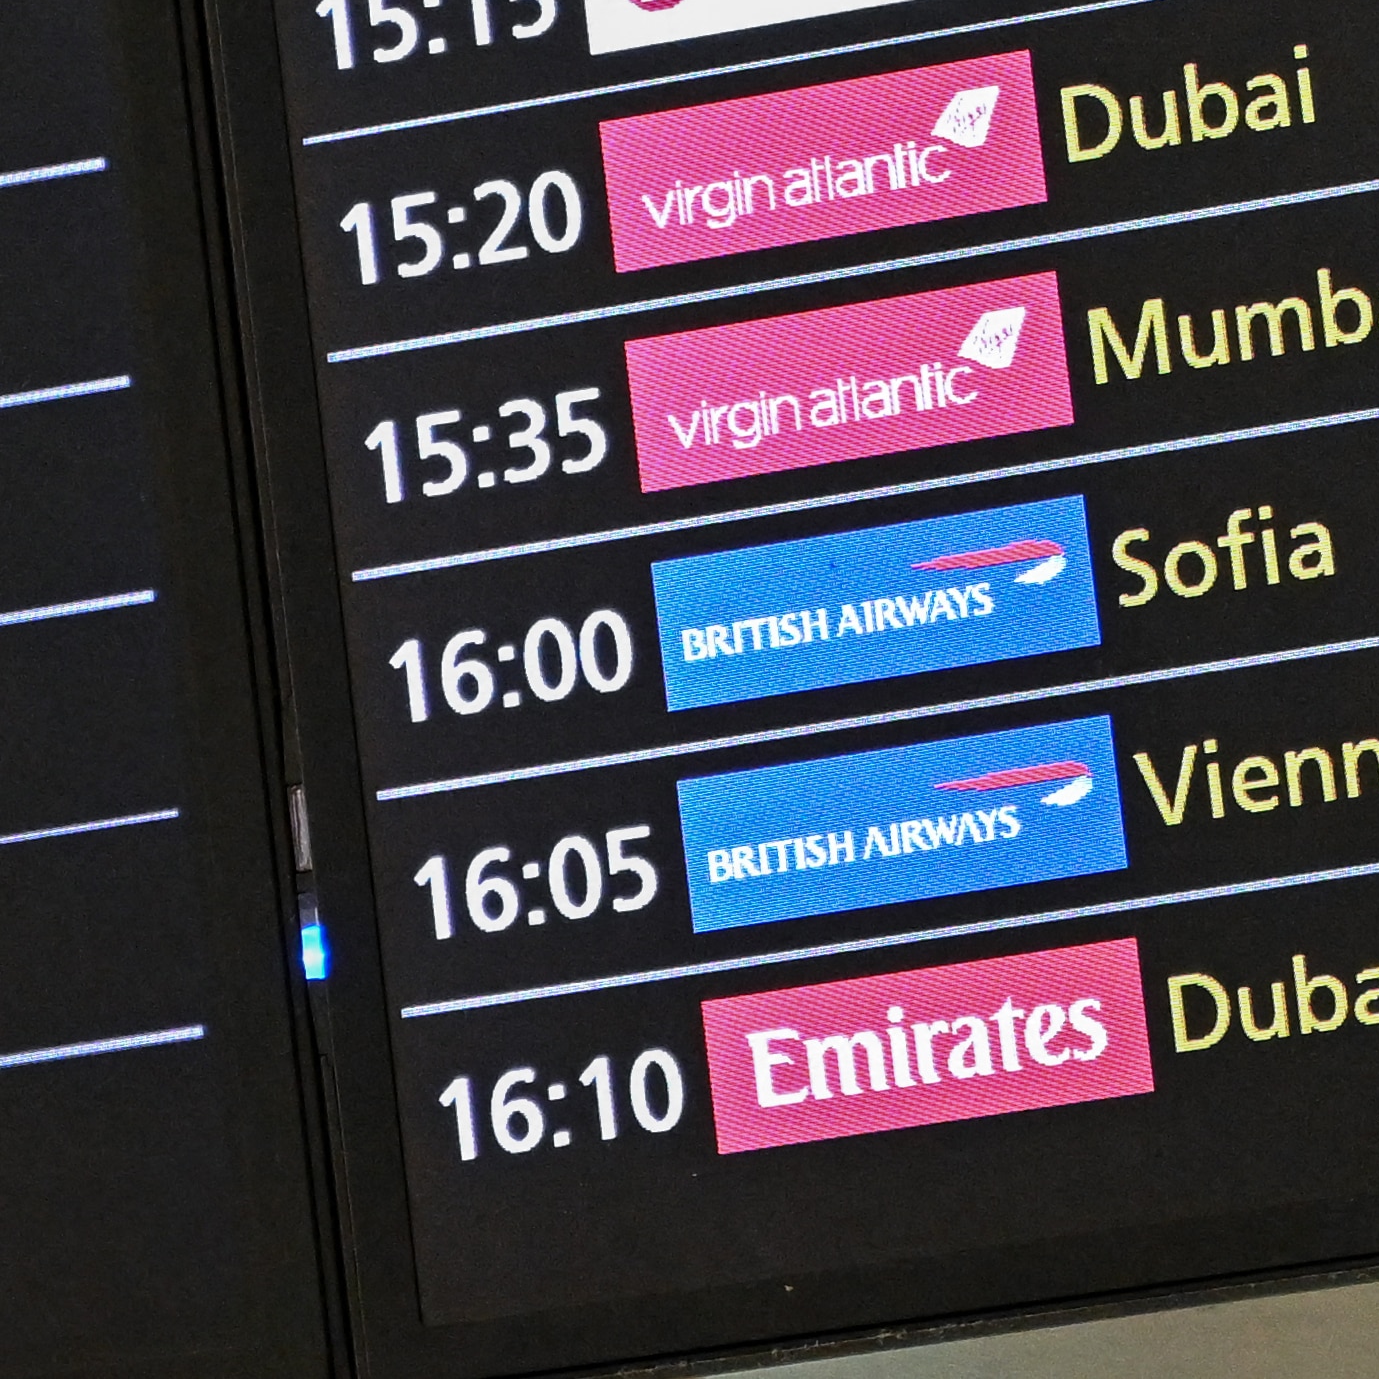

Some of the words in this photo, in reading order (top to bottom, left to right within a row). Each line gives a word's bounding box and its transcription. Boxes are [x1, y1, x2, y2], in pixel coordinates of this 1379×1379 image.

[1061, 45, 1315, 162] Dubai
[340, 170, 582, 285] 15:20
[640, 171, 777, 229] virgin
[783, 141, 952, 206] atlantic
[365, 388, 606, 503] 15:35
[666, 391, 804, 449] virgin
[808, 362, 979, 427] atlantic
[1112, 506, 1334, 607] Sofia
[389, 609, 633, 722] 16:00
[682, 608, 828, 661] BRITISH
[837, 583, 995, 636] AIRWAYS
[414, 825, 657, 940] 16:05
[708, 831, 855, 882] BRITISH
[864, 805, 1021, 859] AIRWAYS
[439, 1049, 683, 1161] 16:10
[745, 996, 1109, 1108] Emirates
